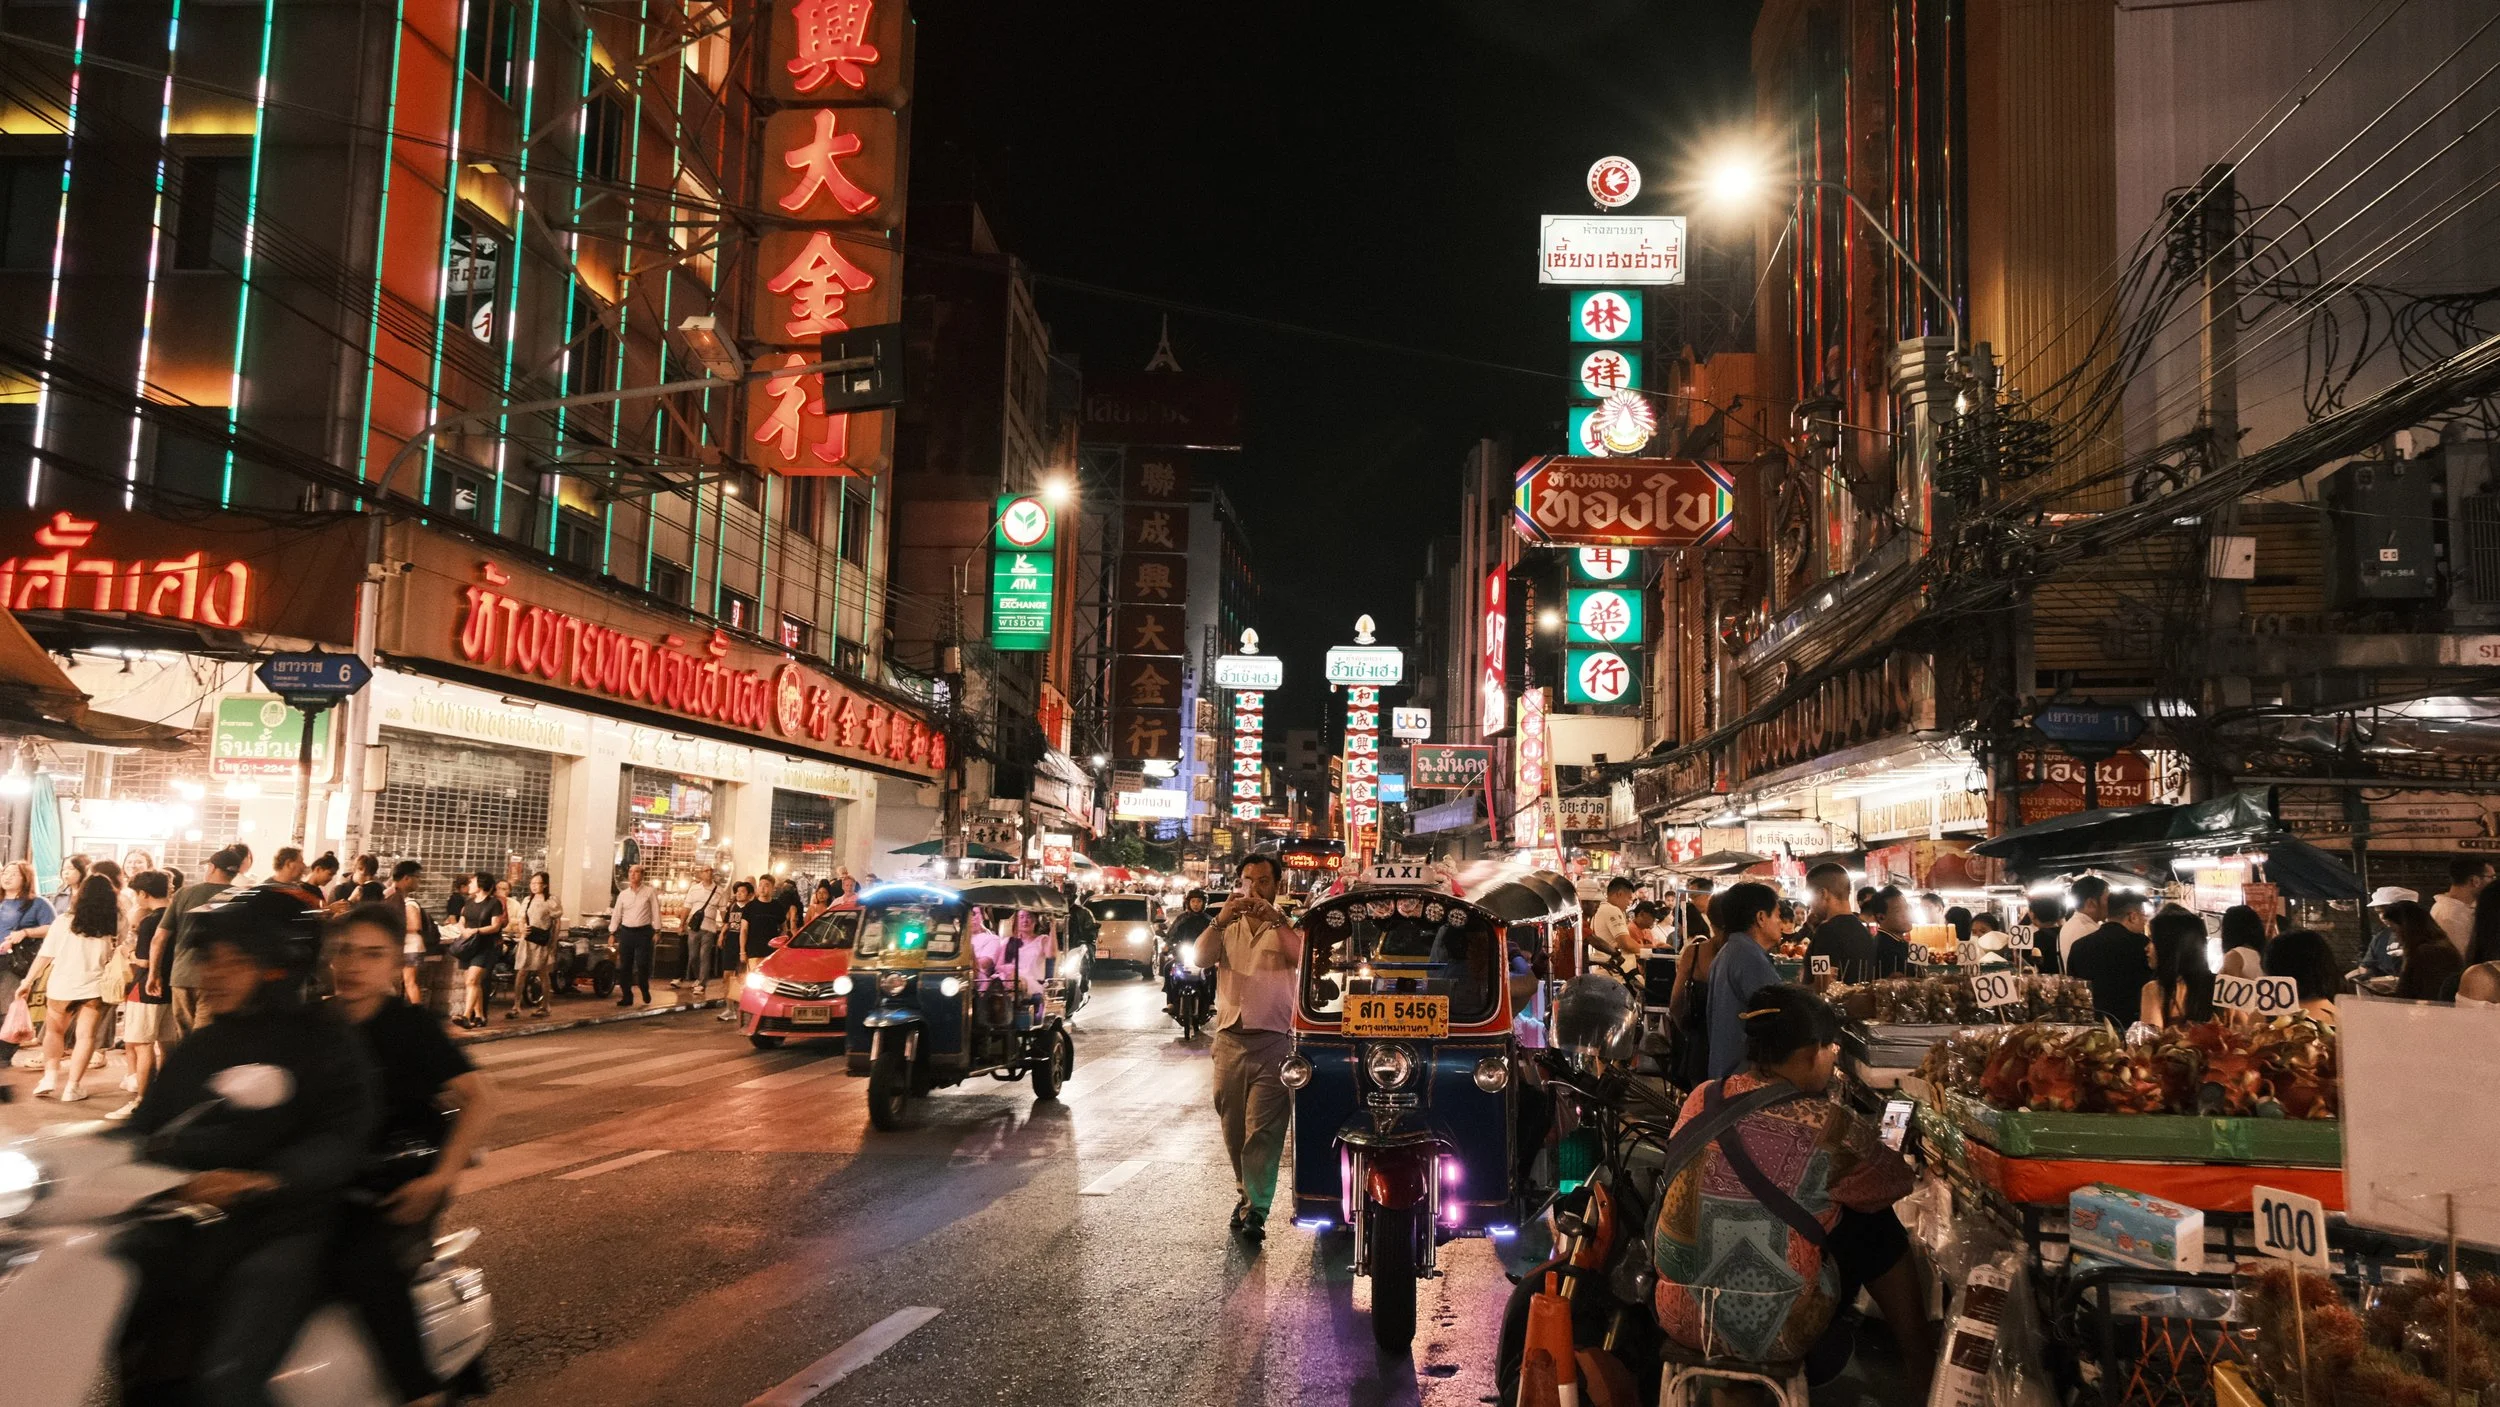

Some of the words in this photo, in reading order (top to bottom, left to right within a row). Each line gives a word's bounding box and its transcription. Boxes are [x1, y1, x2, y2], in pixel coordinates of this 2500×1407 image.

[1548, 467, 1632, 489] ห้างทอง
[1536, 473, 1712, 532] ทองใบ
[1010, 578, 1037, 590] ATM
[1000, 601, 1048, 609] EXCHANGE
[998, 619, 1045, 627] WISDOM
[273, 661, 324, 673] เยาวราช
[338, 663, 351, 682] 6
[1396, 712, 1427, 729] ttb
[2113, 715, 2131, 732] 11
[1326, 856, 1340, 868] 40
[1375, 867, 1422, 879] TAXI
[2009, 925, 2031, 946] 80
[1908, 943, 1928, 963] 80
[1956, 942, 1977, 963] 80
[1812, 959, 1829, 973] 50
[1975, 974, 2009, 1003] 80
[2214, 978, 2253, 1007] 100
[2256, 979, 2295, 1011] 80
[1394, 1002, 1438, 1019] 5456
[1361, 1023, 1429, 1034] กรุงเทพมหานคร
[2261, 1198, 2316, 1257] 100
